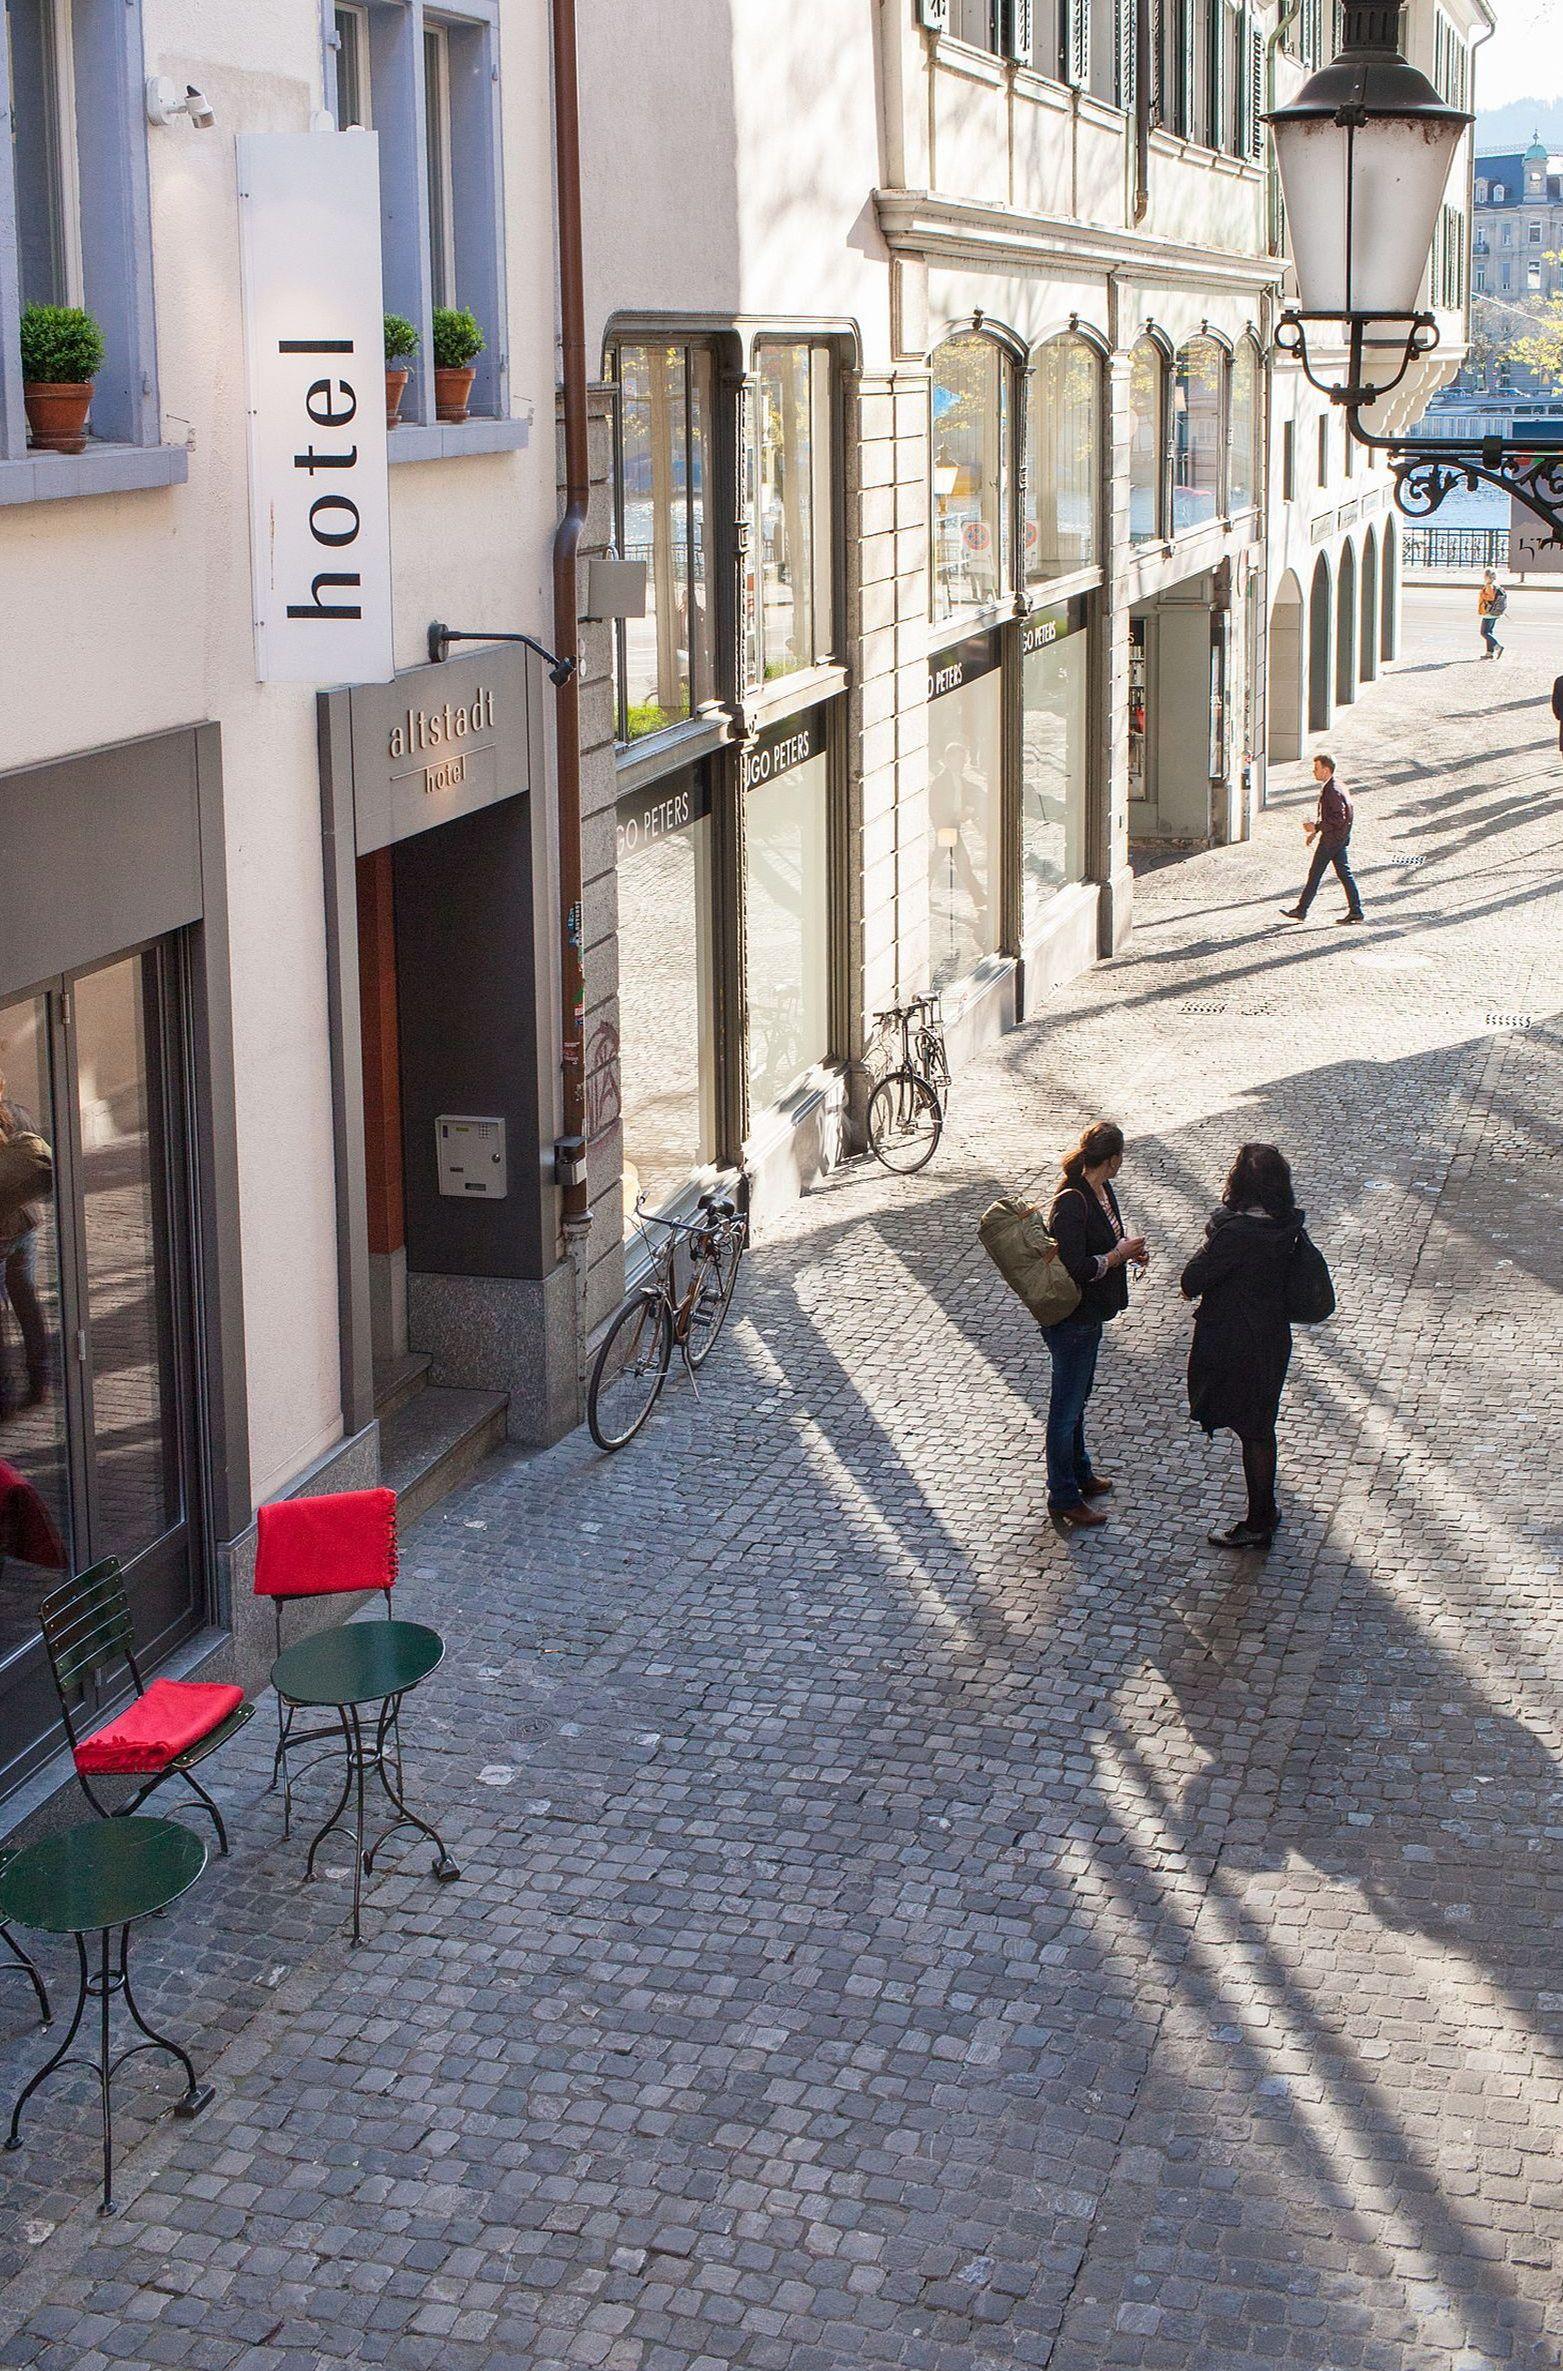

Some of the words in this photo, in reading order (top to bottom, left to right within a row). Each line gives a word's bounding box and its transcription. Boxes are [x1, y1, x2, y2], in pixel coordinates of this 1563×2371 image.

[279, 340, 362, 619] hotel
[1035, 620, 1056, 647] PETERS
[936, 662, 963, 694] PETERS
[390, 687, 495, 758] altstadt
[774, 730, 809, 772] PETERS
[425, 755, 467, 794] hotel
[644, 792, 689, 841] PETERS
